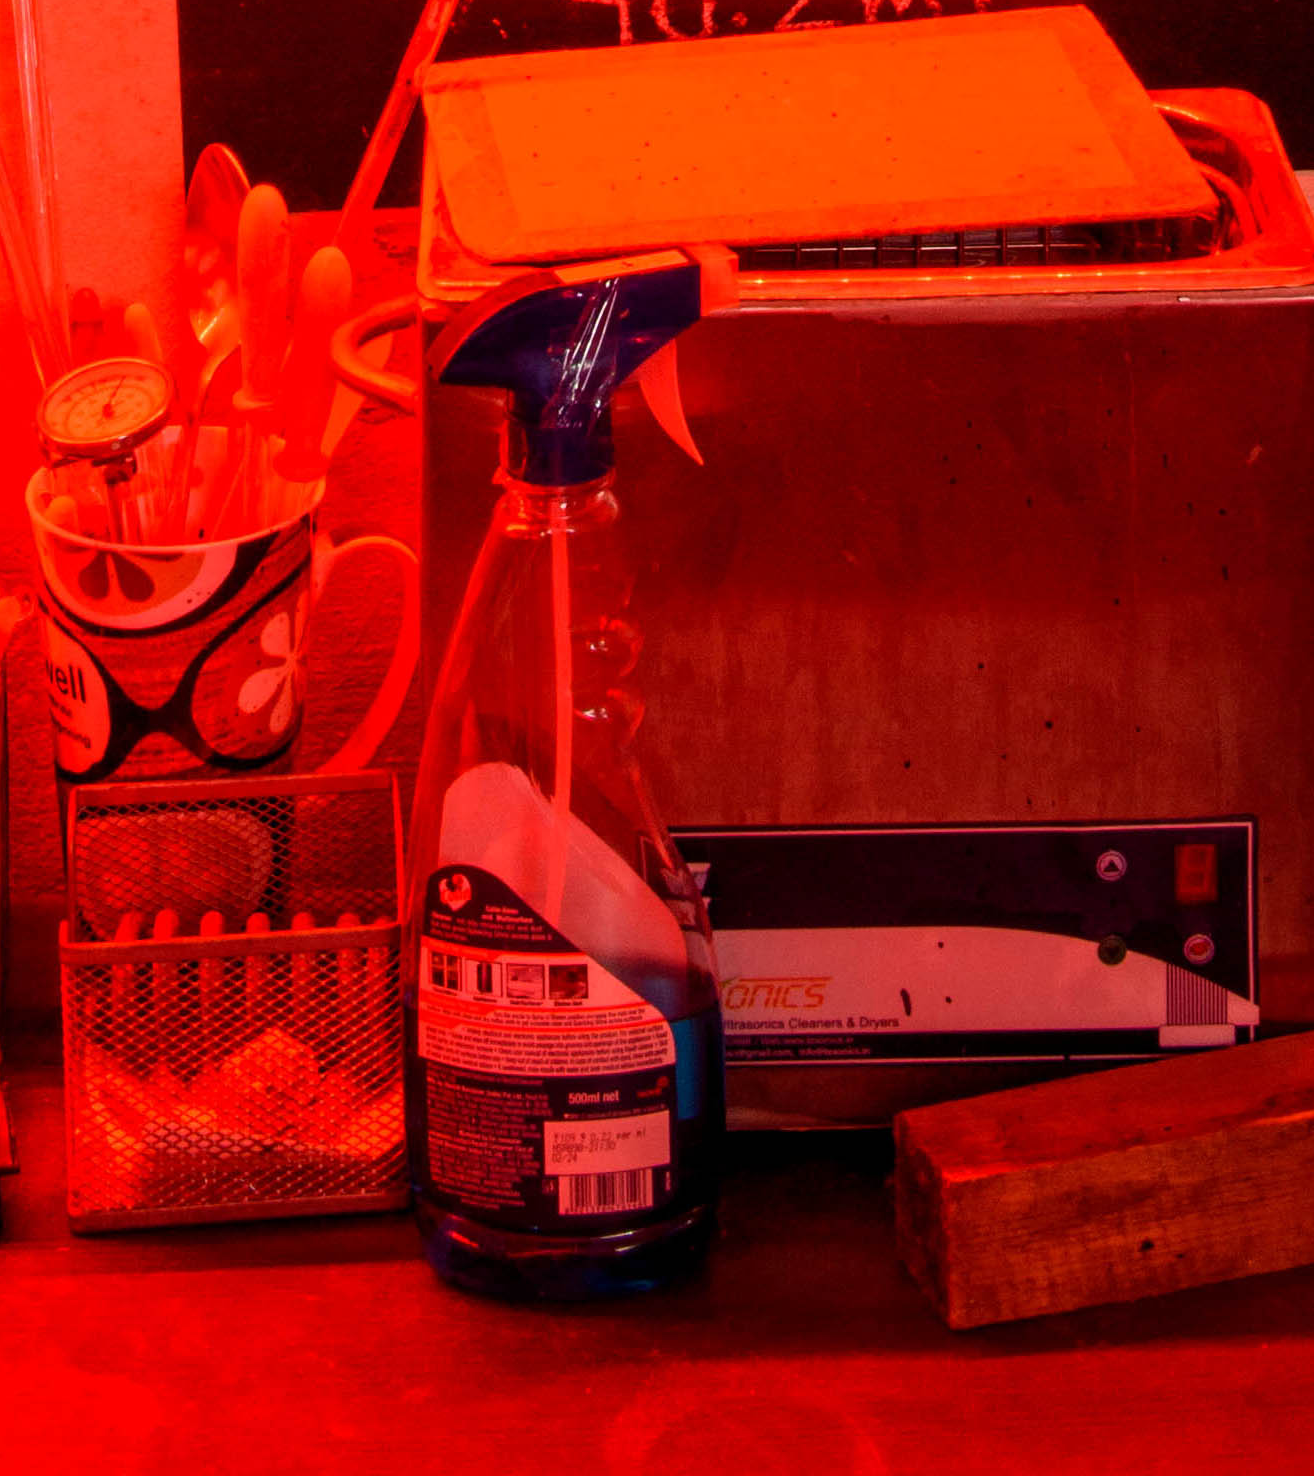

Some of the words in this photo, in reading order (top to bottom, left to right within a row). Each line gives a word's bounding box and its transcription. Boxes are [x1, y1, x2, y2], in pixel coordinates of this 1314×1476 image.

[788, 1017, 843, 1029] Cleaners
[846, 1017, 856, 1029] &
[859, 1016, 900, 1031] Dryers
[568, 1091, 601, 1105] 500ml
